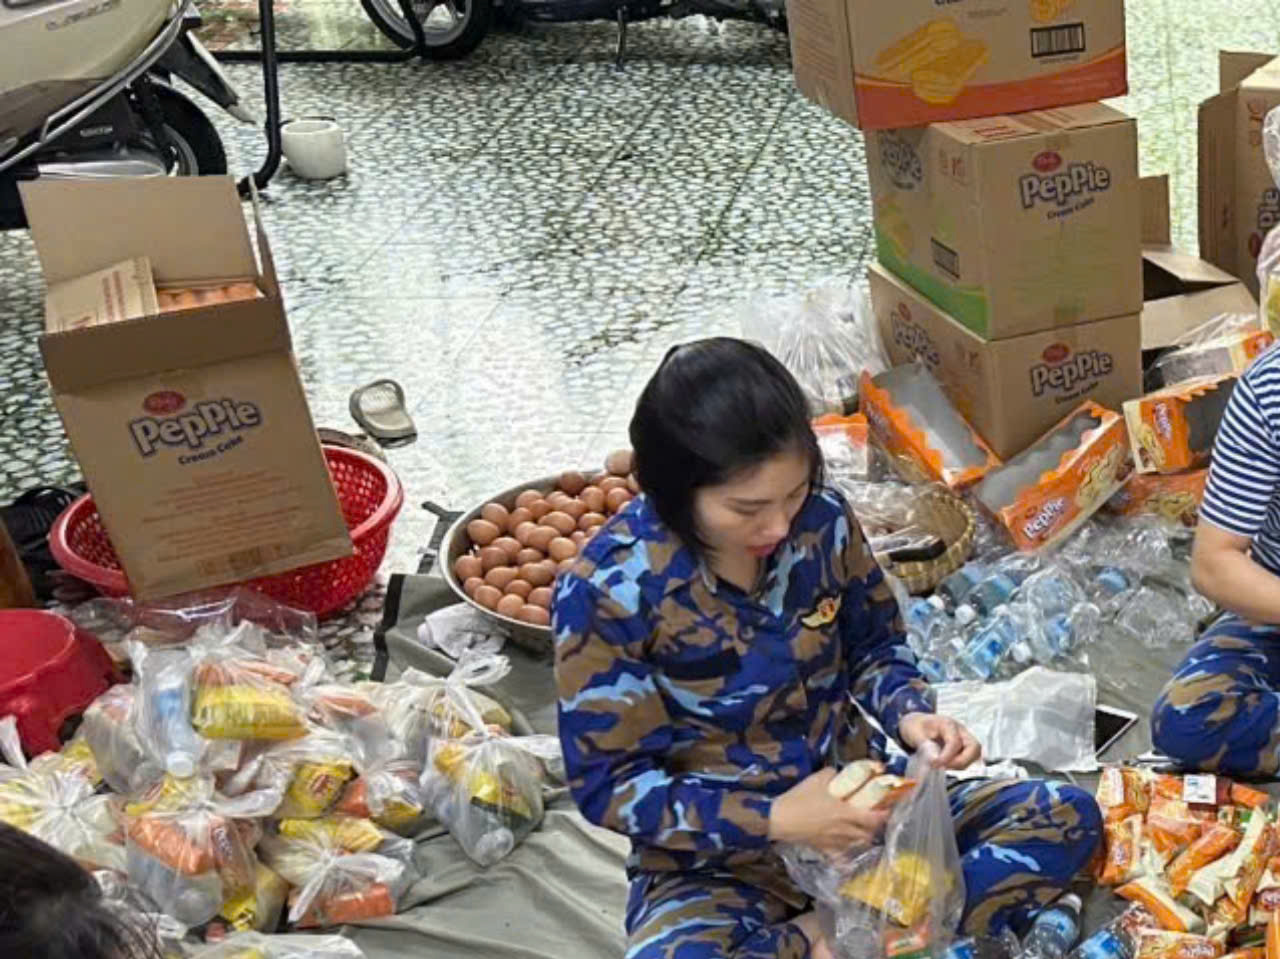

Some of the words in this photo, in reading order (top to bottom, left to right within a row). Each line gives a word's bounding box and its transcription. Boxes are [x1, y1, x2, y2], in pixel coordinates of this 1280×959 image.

[1020, 160, 1111, 209] PepPie
[1030, 351, 1112, 397] PepPie
[129, 397, 262, 458] PepPie
